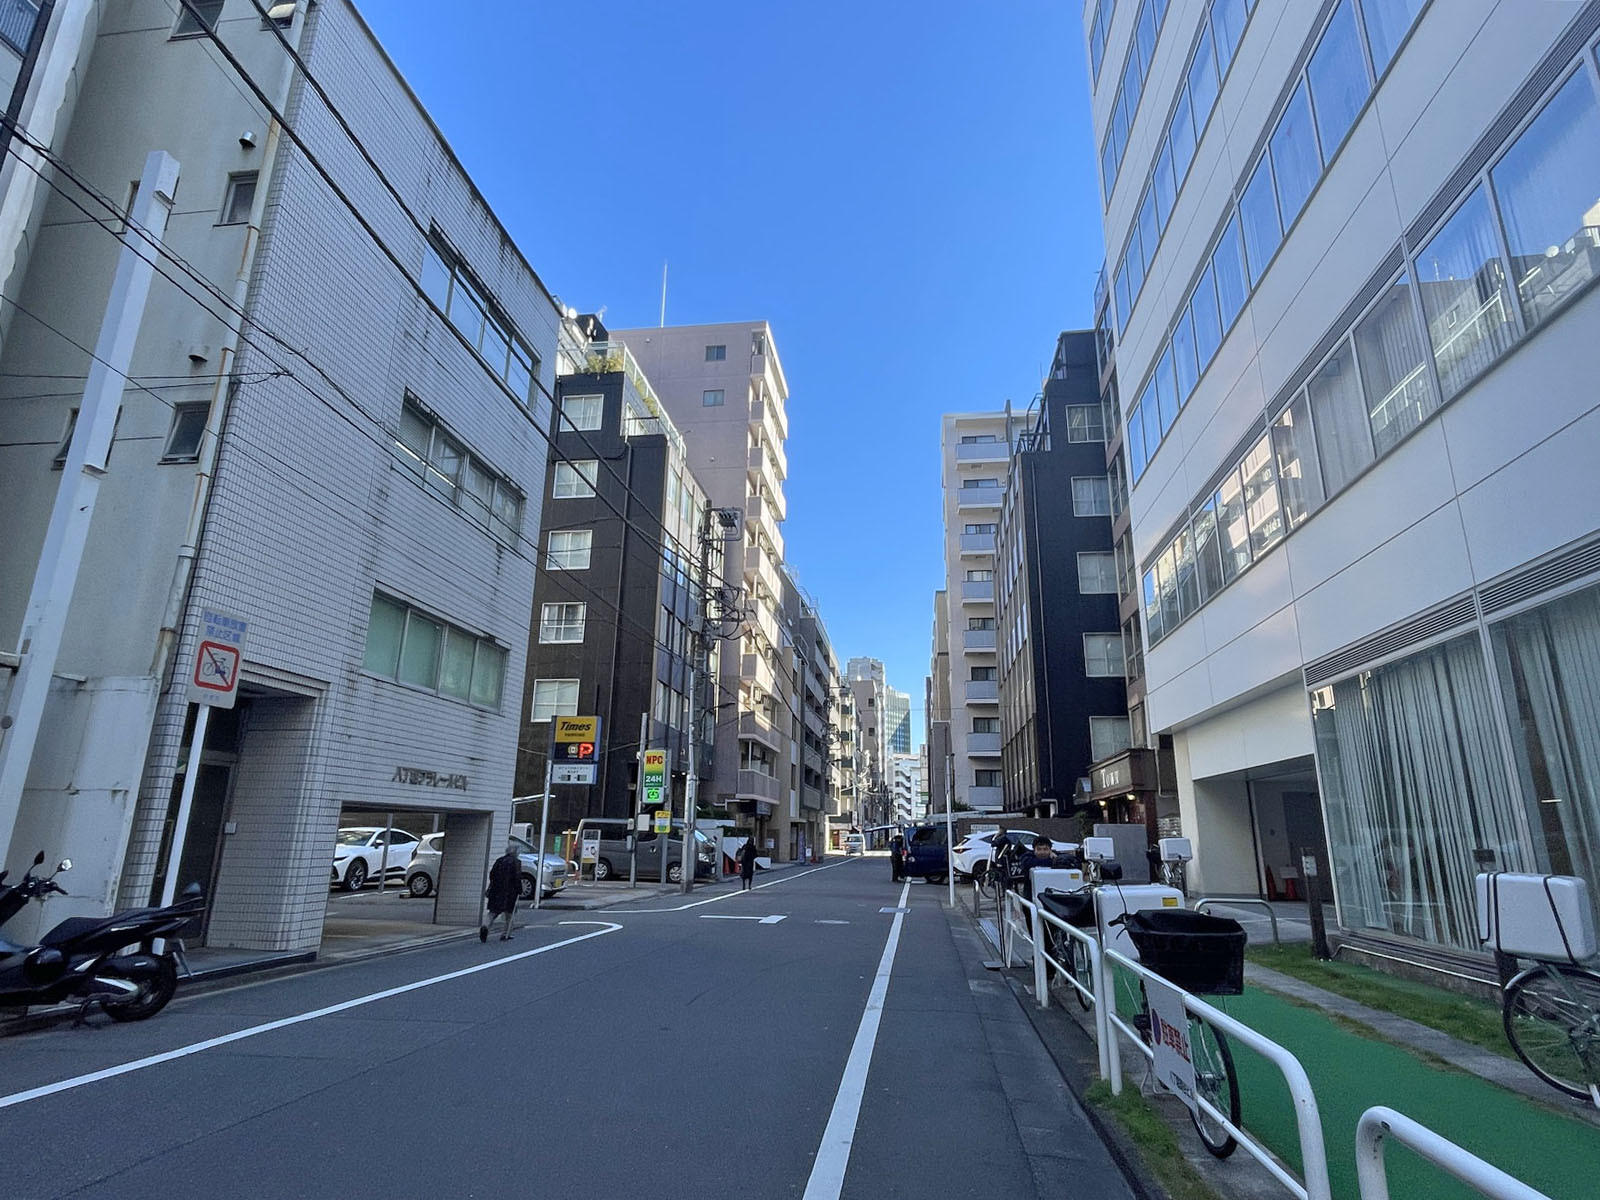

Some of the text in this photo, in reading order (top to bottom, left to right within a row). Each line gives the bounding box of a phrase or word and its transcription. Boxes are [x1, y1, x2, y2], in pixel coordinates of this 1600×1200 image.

[560, 721, 592, 731] Times
[579, 743, 593, 758] P
[646, 755, 663, 764] NPC
